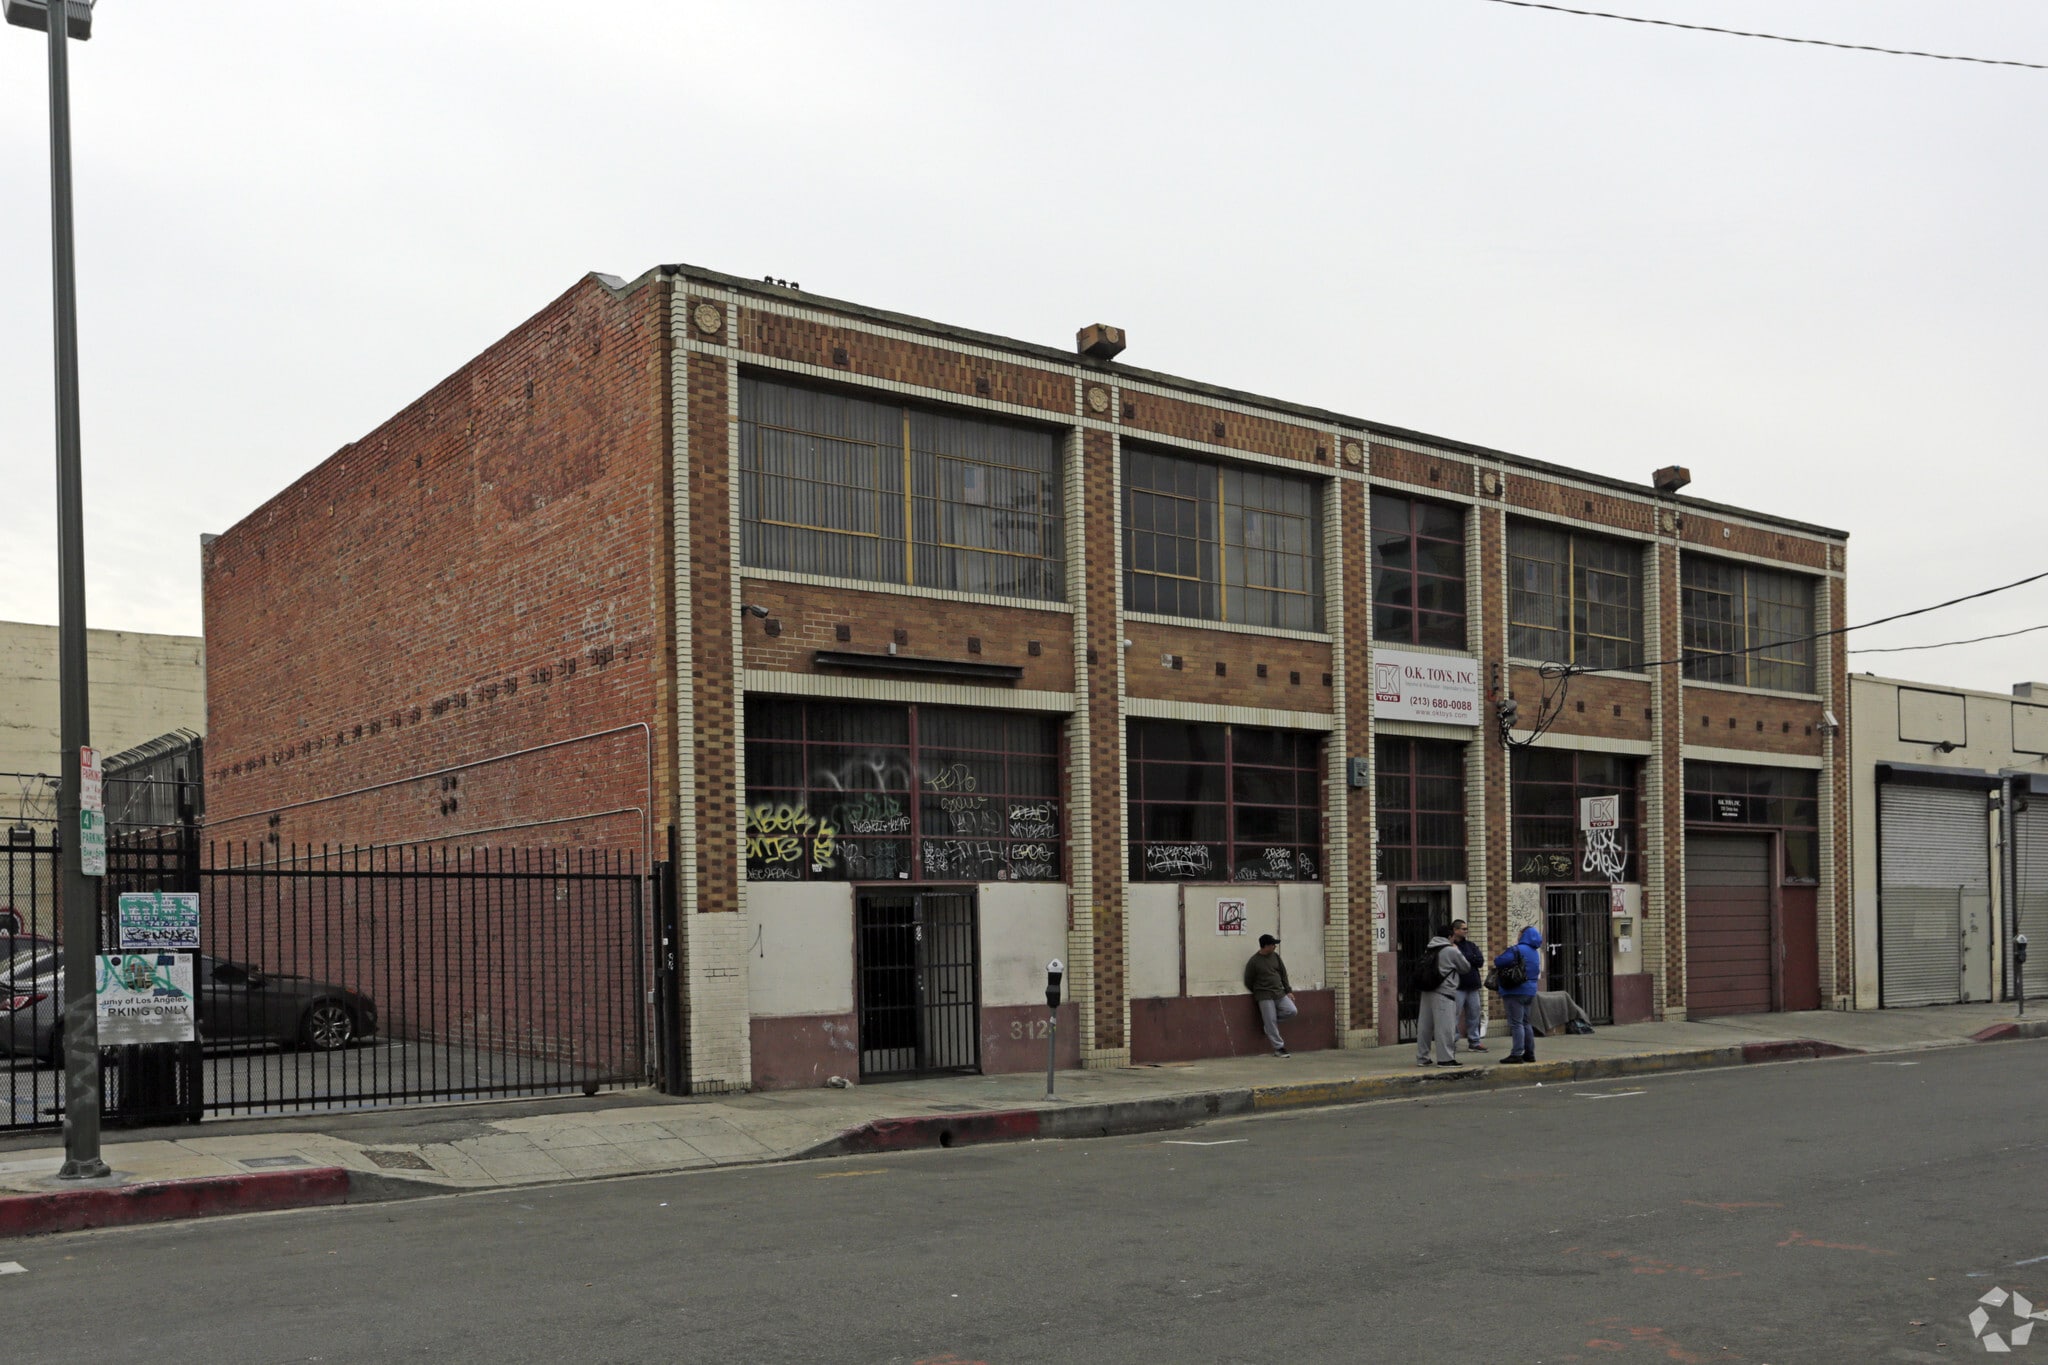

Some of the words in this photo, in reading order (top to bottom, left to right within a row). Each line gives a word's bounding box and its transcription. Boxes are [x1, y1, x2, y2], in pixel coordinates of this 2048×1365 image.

[1377, 666, 1399, 693] OK
[1404, 665, 1426, 680] O.K.
[1427, 667, 1455, 684] TOYS,
[1457, 671, 1476, 685] INC.
[1378, 694, 1398, 702] TOYS
[1409, 696, 1430, 708] (213)
[1432, 698, 1472, 711] 680-0088
[82, 749, 91, 766] NO
[82, 768, 101, 781] PARKING
[1590, 799, 1614, 821] OK
[83, 813, 90, 828] 4
[82, 832, 104, 845] PARKING
[153, 996, 187, 1005] Angeles
[107, 1006, 150, 1017] RKING
[154, 1005, 189, 1016] ONLY
[1010, 1020, 1049, 1040] 312
